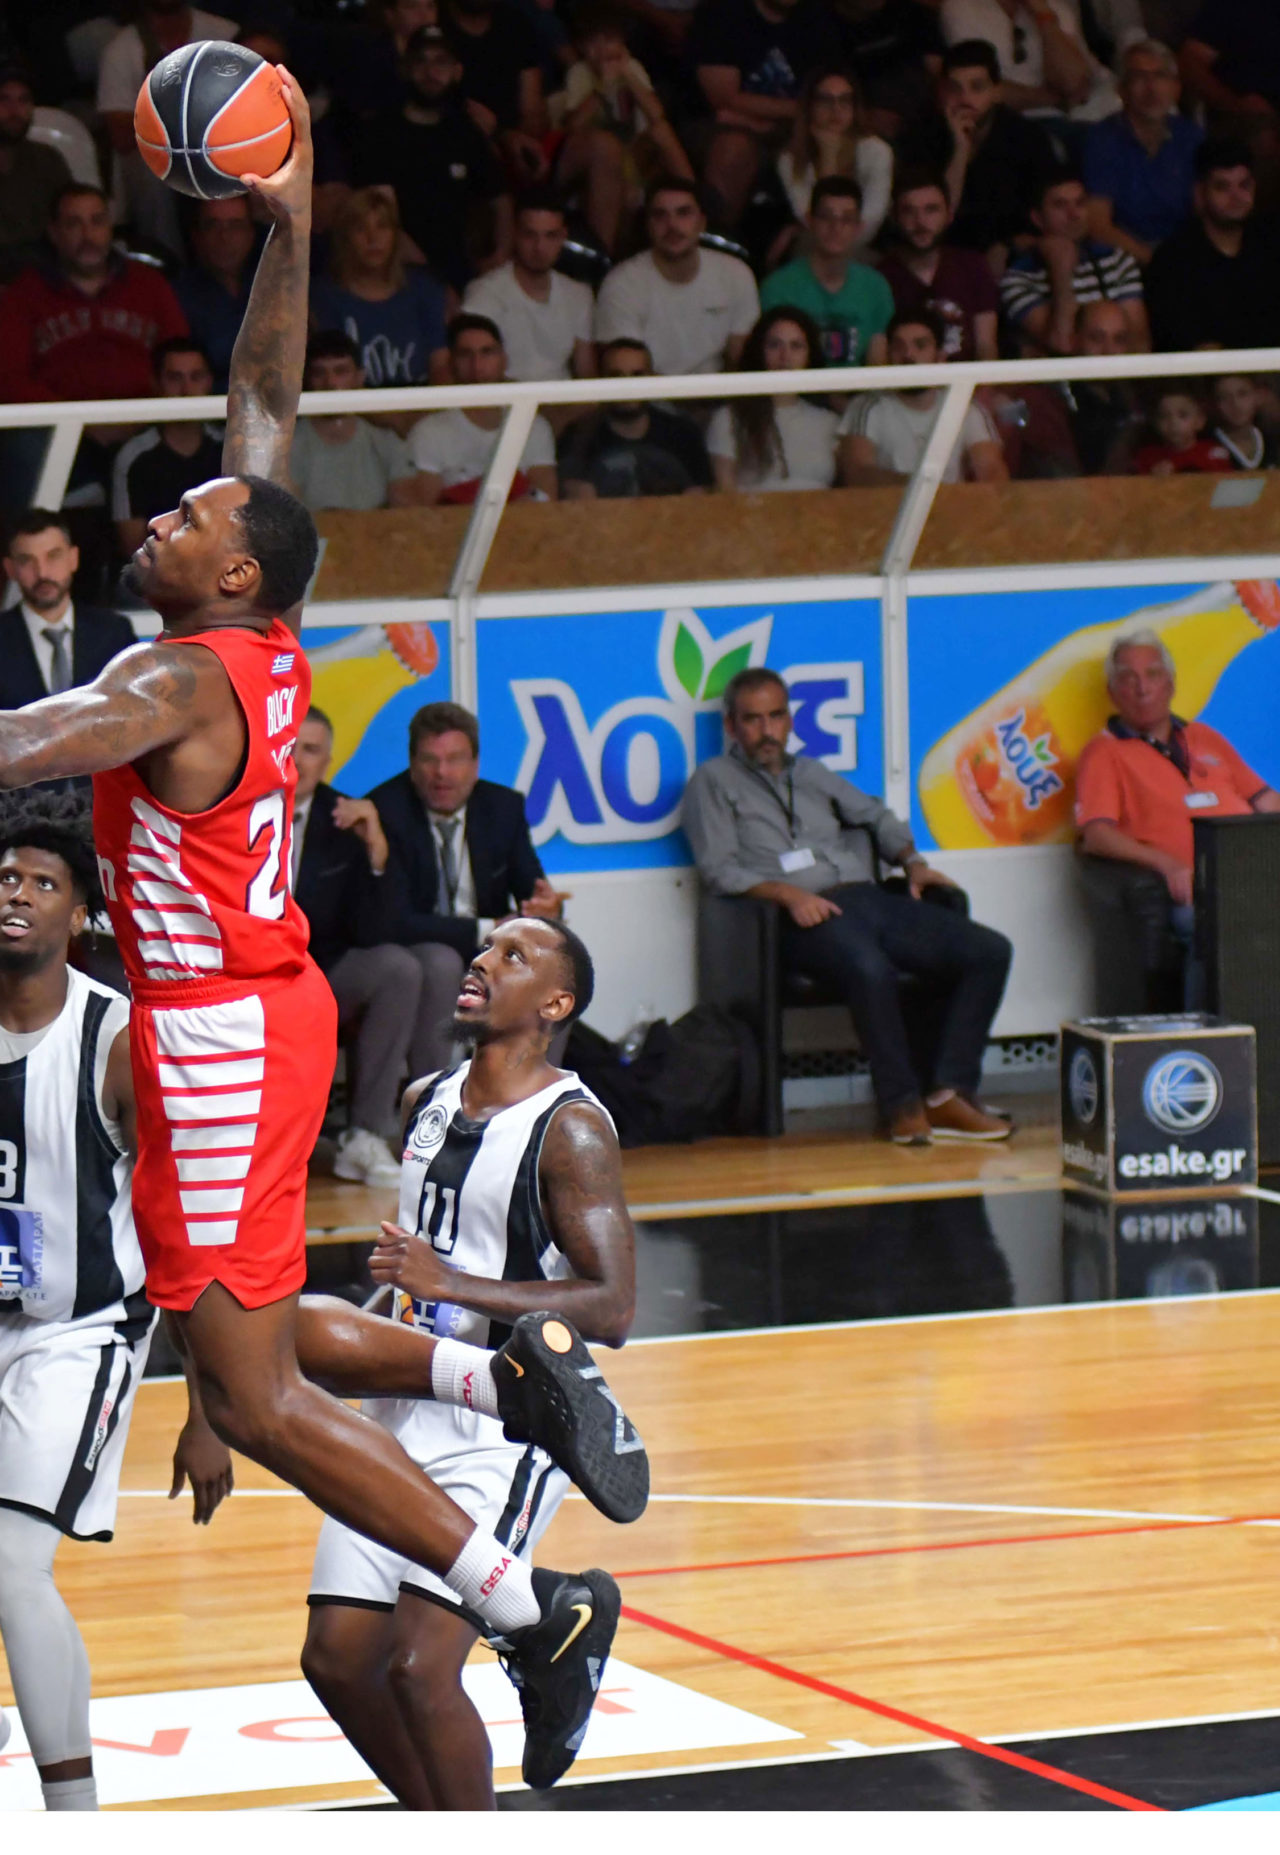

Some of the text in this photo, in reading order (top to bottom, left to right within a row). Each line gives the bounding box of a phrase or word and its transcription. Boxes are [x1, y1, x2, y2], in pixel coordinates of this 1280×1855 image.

[1120, 1144, 1247, 1180] esake.gr
[417, 1181, 457, 1252] 11
[480, 1556, 513, 1598] GSA
